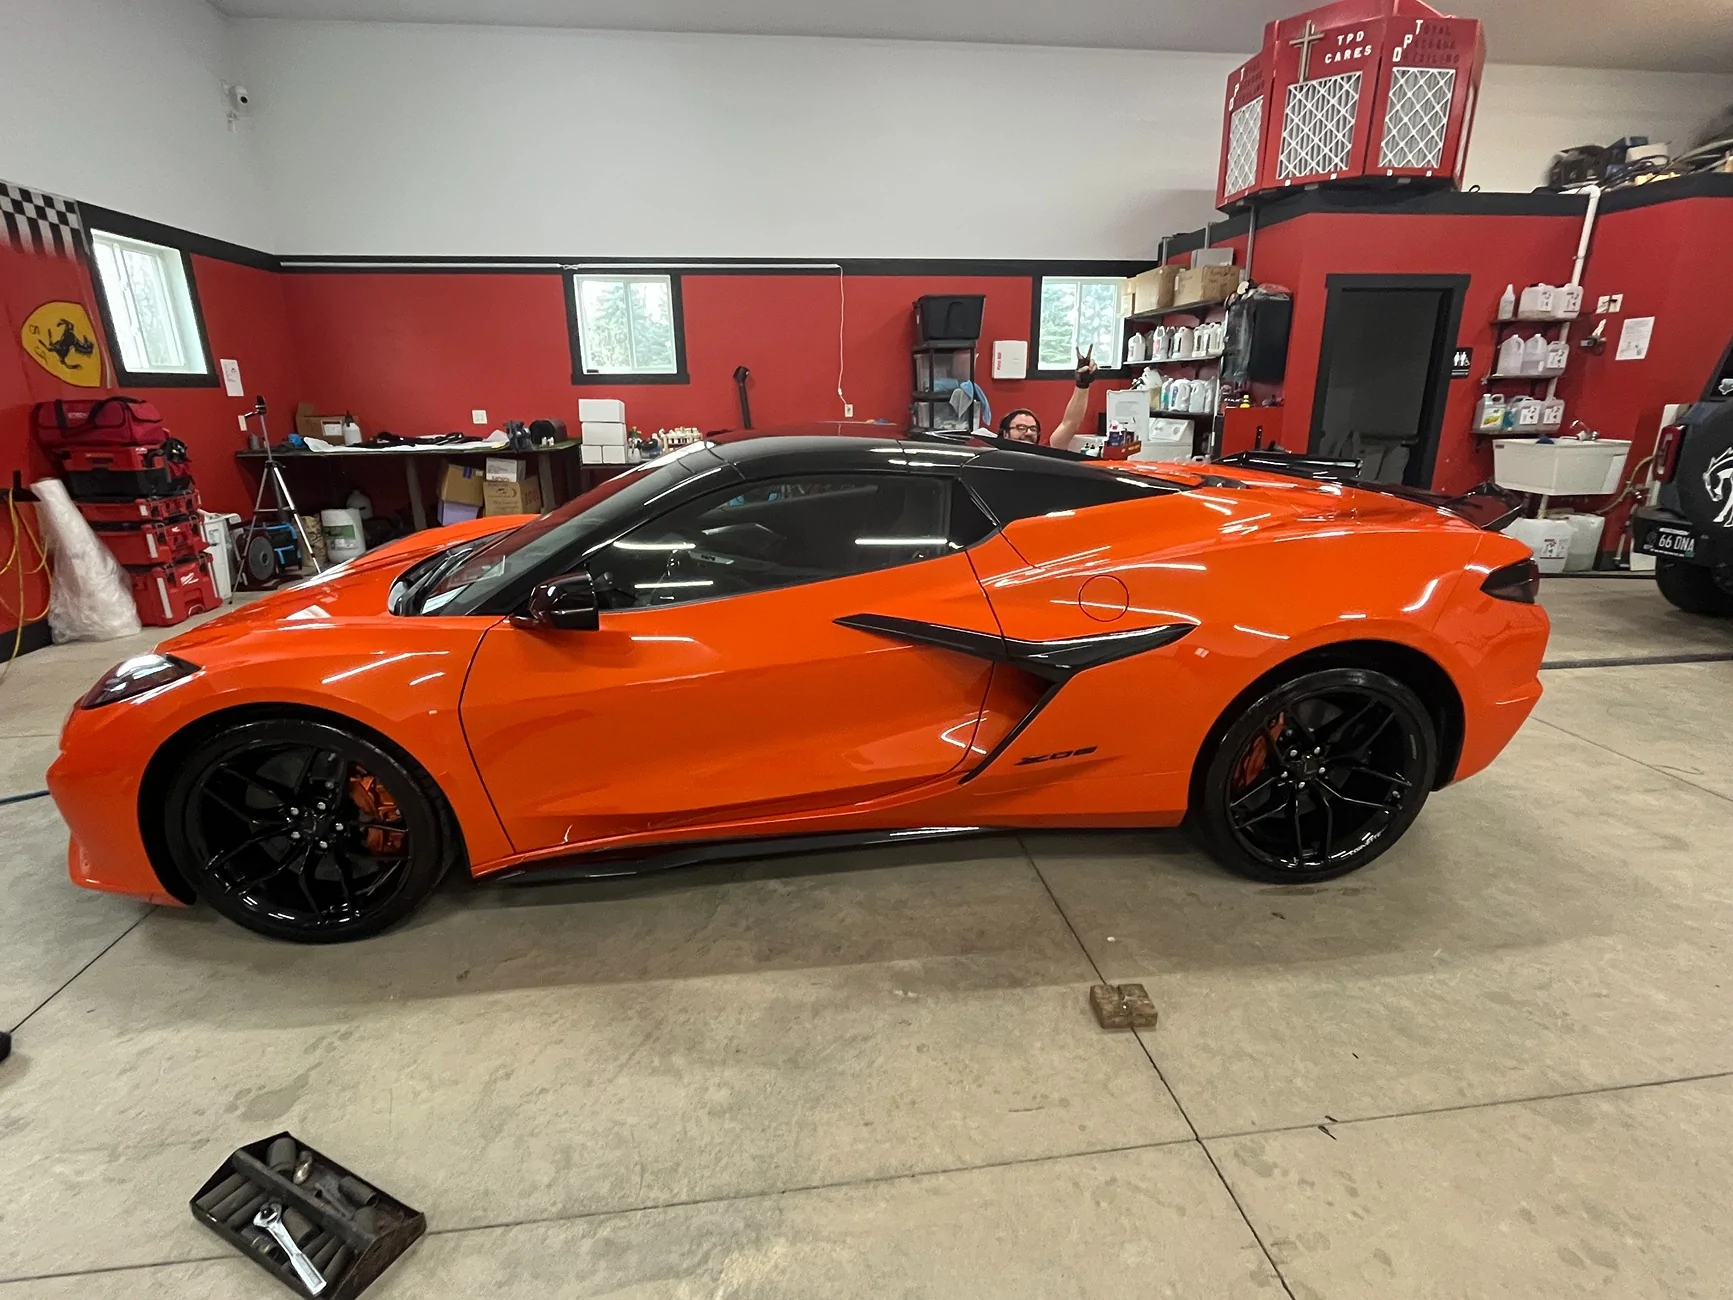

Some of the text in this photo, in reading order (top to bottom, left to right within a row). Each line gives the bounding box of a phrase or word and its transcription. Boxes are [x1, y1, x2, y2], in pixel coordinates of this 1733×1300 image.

[1337, 30, 1365, 46] TPD
[1324, 44, 1372, 64] CARES
[1658, 534, 1673, 549] 66
[1673, 536, 1695, 553] DNA
